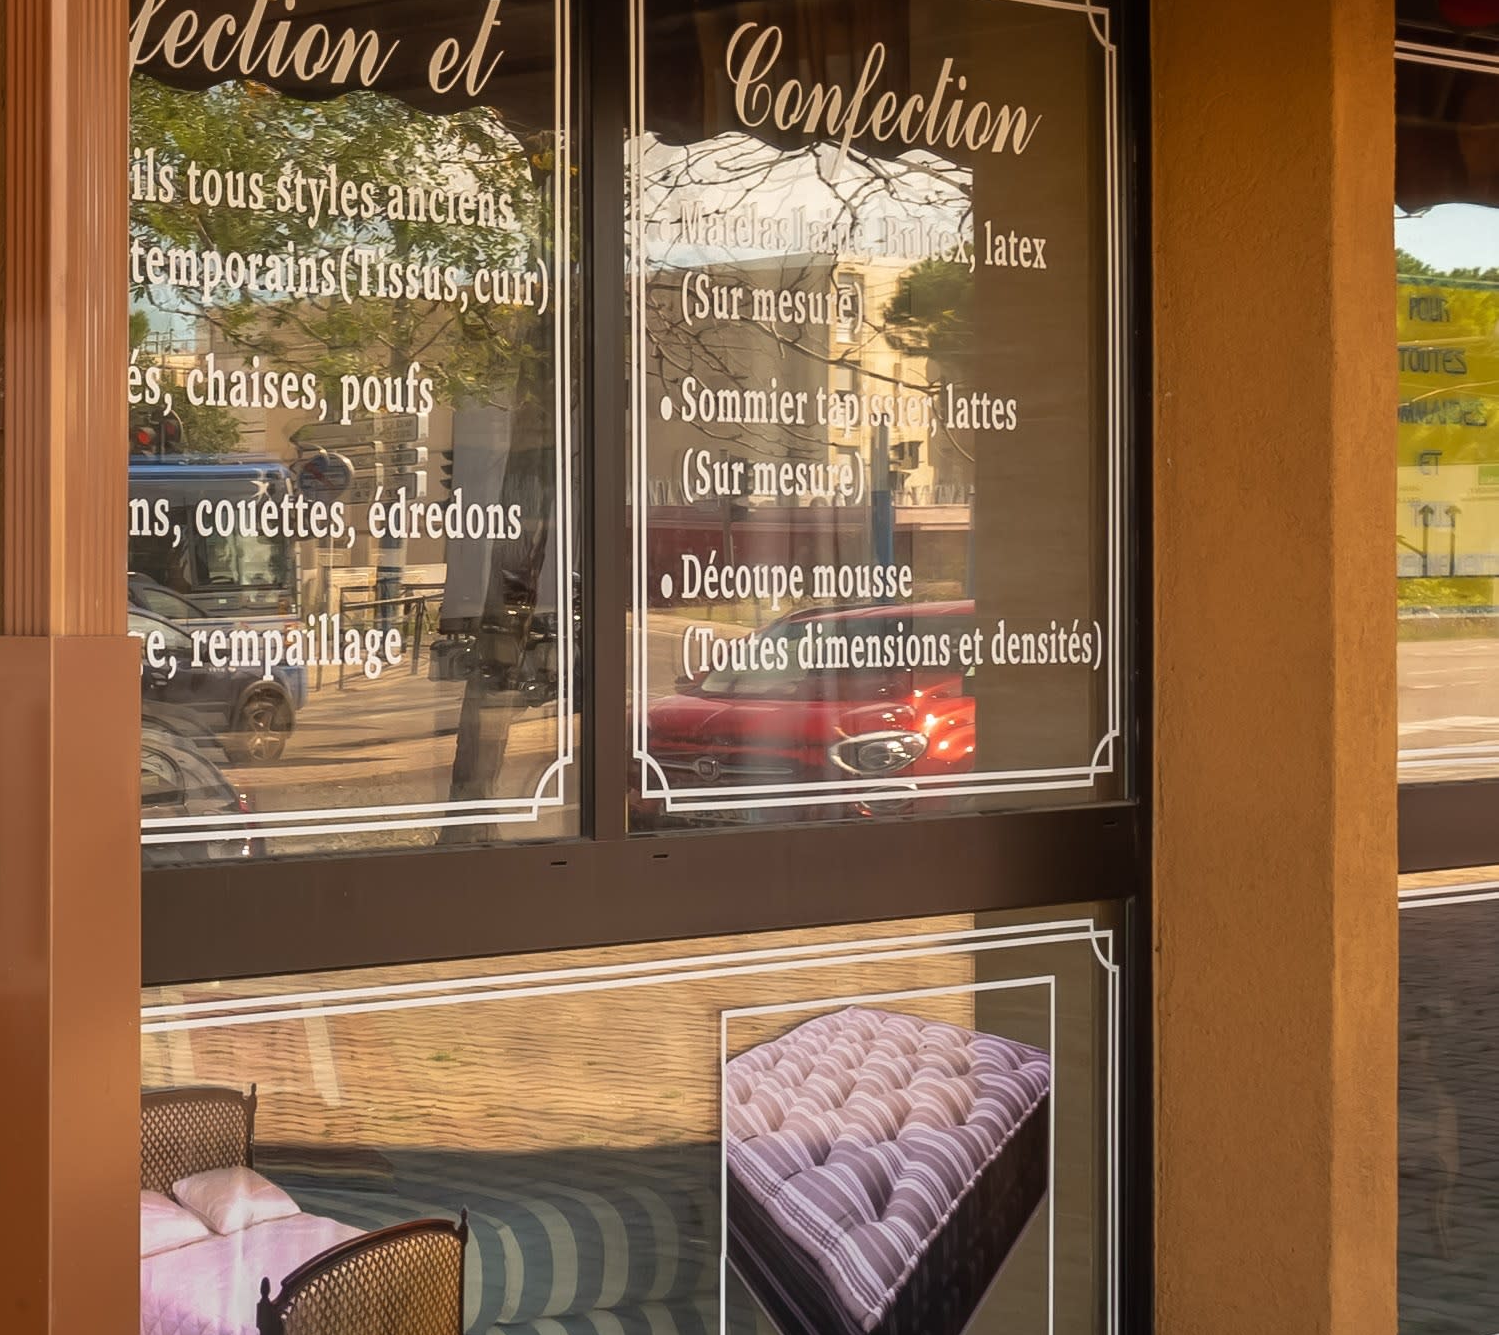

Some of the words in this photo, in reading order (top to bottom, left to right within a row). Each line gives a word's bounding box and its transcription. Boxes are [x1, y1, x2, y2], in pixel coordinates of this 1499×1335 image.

[726, 22, 1042, 181] Confection
[187, 160, 264, 211] tous
[276, 164, 377, 229] styles
[387, 176, 514, 231] anciens
[983, 220, 1047, 270] latex
[681, 271, 743, 326] (Sur
[753, 276, 865, 334] mesure)
[186, 353, 327, 423] chaises,
[340, 362, 434, 425] poufs
[681, 376, 806, 426] Sommier
[816, 383, 939, 440] tapissier,
[945, 383, 1018, 431] lattes
[682, 447, 745, 504] (Sur
[753, 452, 865, 504] mesure)
[195, 498, 355, 548] couettes,
[368, 485, 521, 540] édredons
[681, 551, 804, 612] Découpe
[813, 562, 913, 599] mousse
[191, 613, 402, 681] rempaillage
[682, 623, 789, 681] (Toutes
[797, 622, 951, 670] dimensions
[958, 630, 984, 665] et
[991, 618, 1104, 672] densités)
